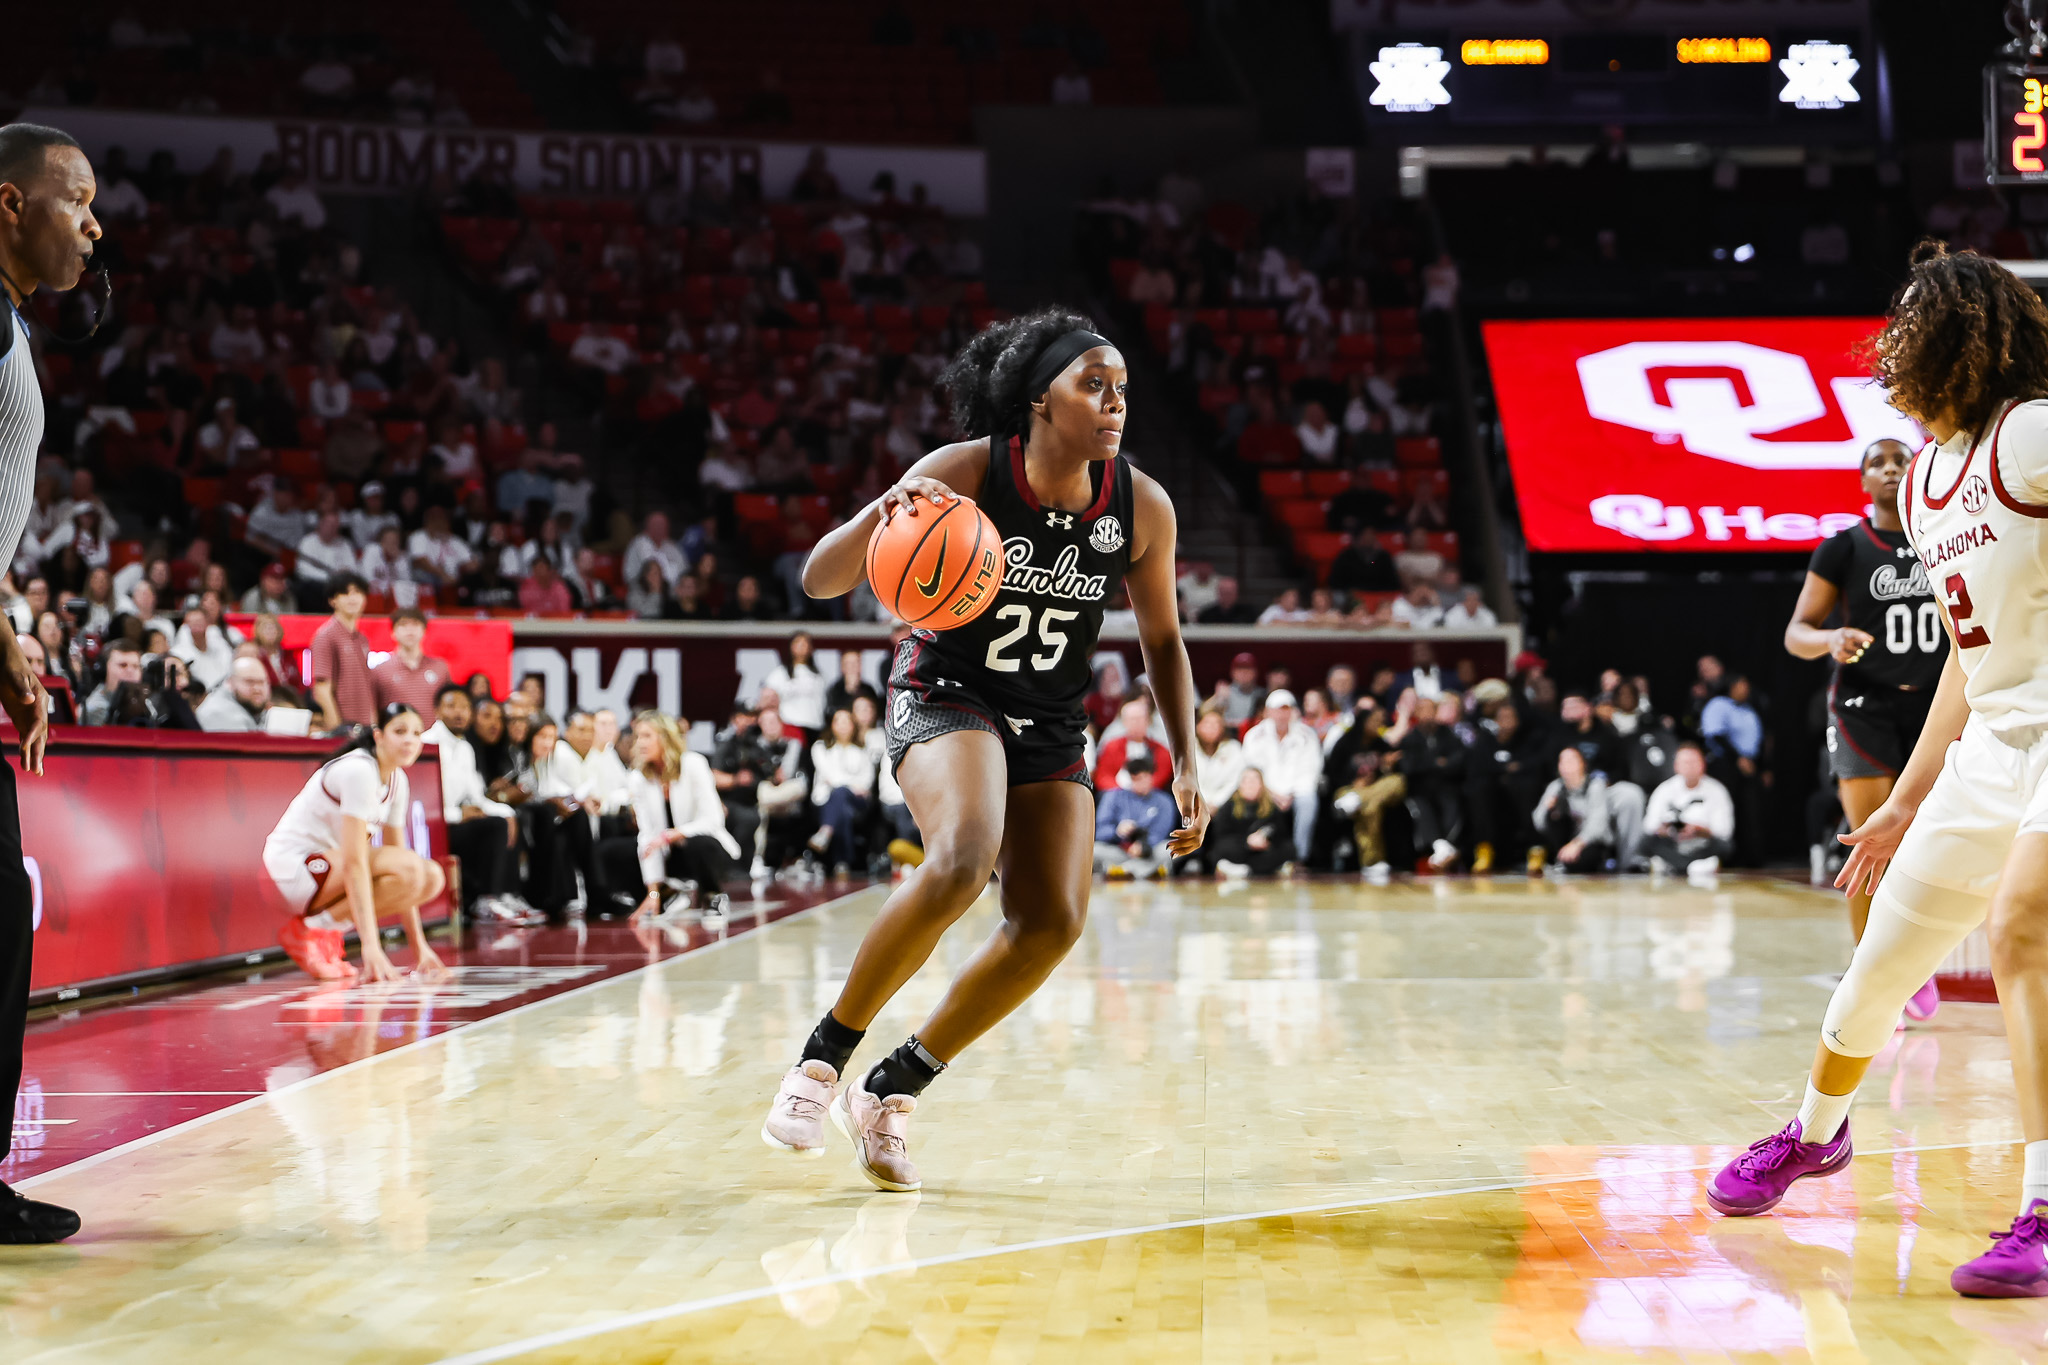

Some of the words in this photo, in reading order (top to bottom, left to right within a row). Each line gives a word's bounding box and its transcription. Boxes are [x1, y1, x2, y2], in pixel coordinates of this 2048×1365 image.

[277, 124, 516, 189] BOOMER
[540, 136, 761, 196] SOONER
[1096, 518, 1120, 544] SEC
[1699, 506, 1876, 541] Hea
[1921, 523, 1997, 572] KLAHOMA
[949, 548, 996, 617] ELITE
[1000, 537, 1106, 601] Carolina
[985, 604, 1079, 672] 25
[1886, 602, 1940, 654] 00
[1945, 573, 1991, 649] 2
